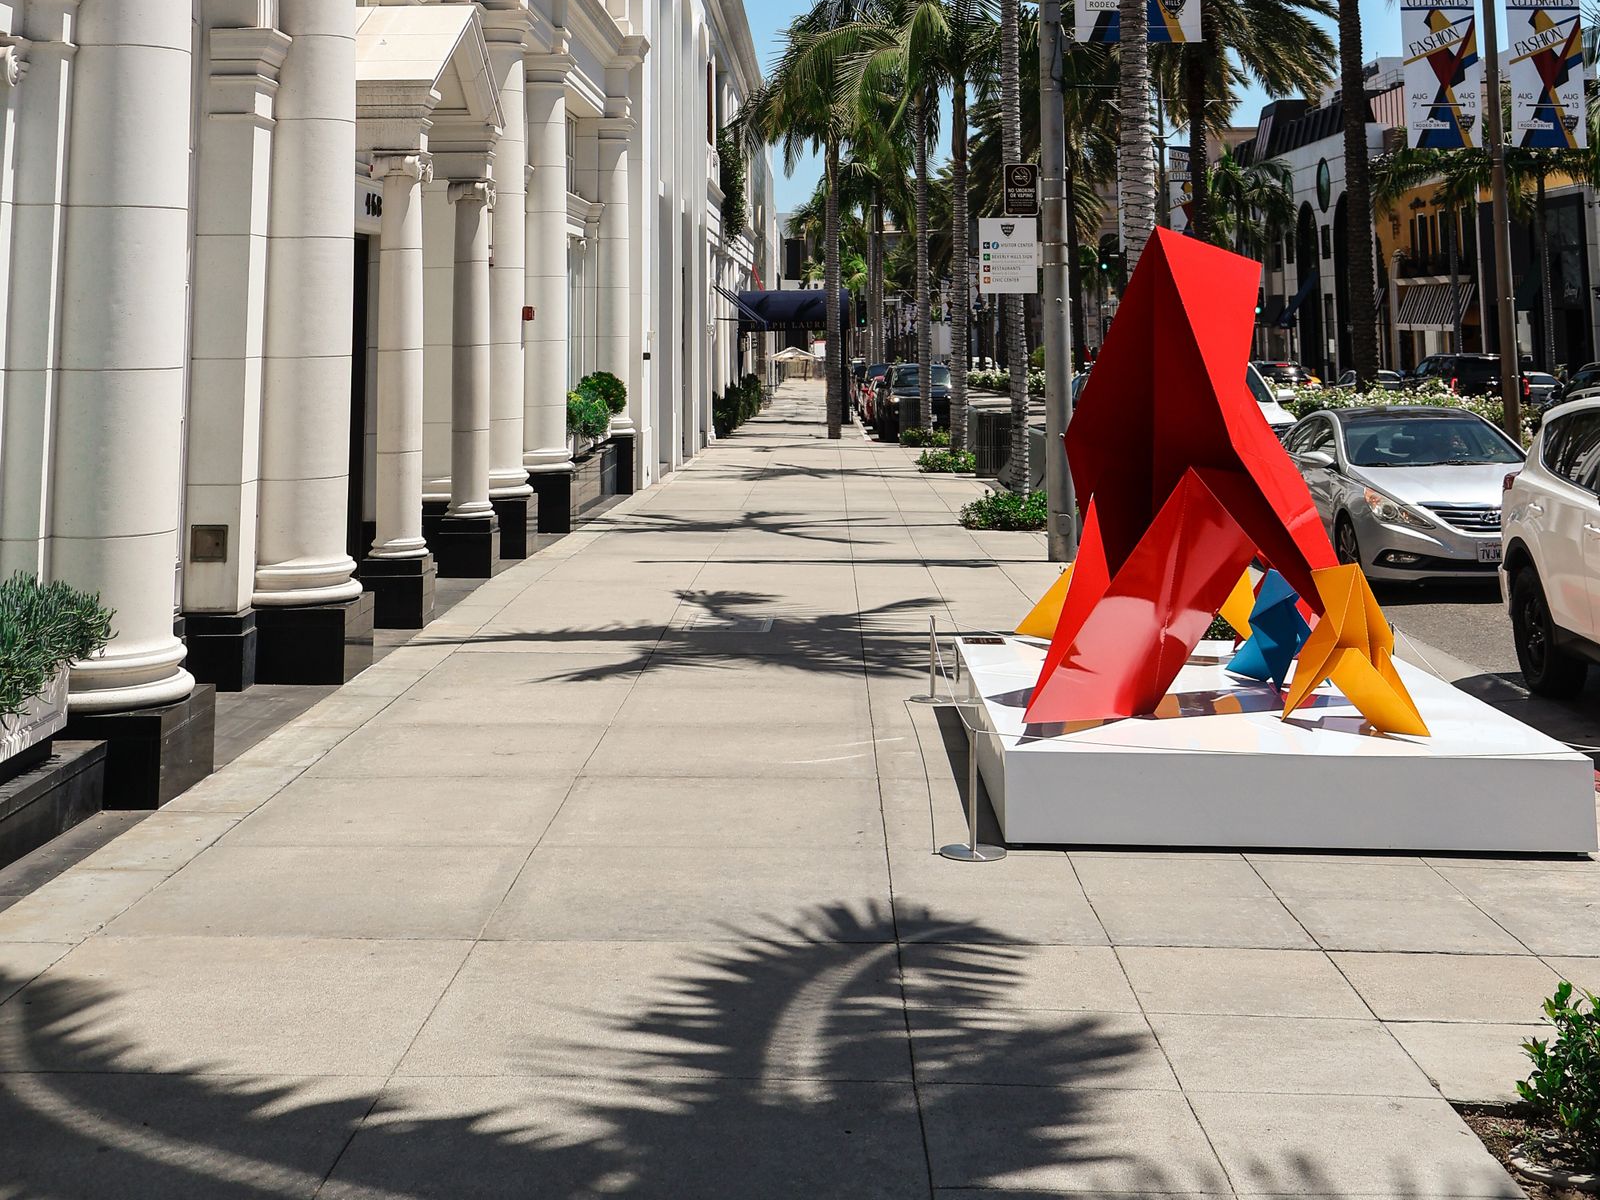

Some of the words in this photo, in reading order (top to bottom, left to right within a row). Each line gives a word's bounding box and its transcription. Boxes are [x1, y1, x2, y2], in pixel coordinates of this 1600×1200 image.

[1409, 26, 1459, 56] FASHION
[1514, 26, 1564, 56] FASHION
[1412, 92, 1428, 100] AUG
[1517, 92, 1533, 100] AUG
[1480, 549, 1501, 560] 7VJW
